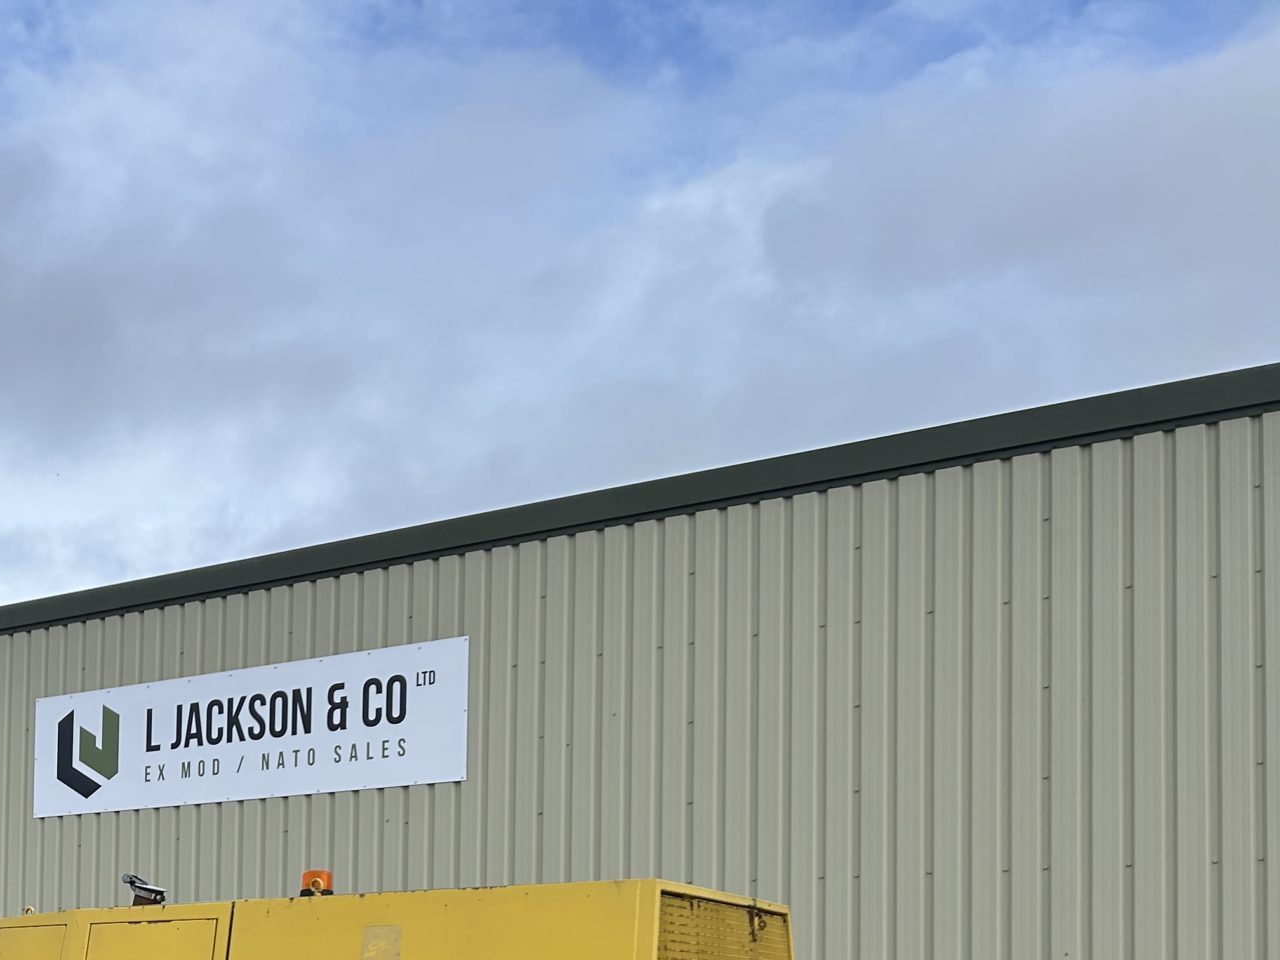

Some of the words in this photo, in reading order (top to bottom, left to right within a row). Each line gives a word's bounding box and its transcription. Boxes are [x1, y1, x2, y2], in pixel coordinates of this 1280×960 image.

[146, 708, 161, 752] L
[170, 687, 313, 750] JACKSON
[326, 682, 349, 732] &
[362, 674, 407, 727] CO
[416, 670, 436, 687] LTD
[144, 764, 166, 782] EX
[181, 758, 220, 779] MOD
[236, 755, 245, 774] /
[261, 748, 316, 771] NATO
[333, 738, 407, 763] SALES
